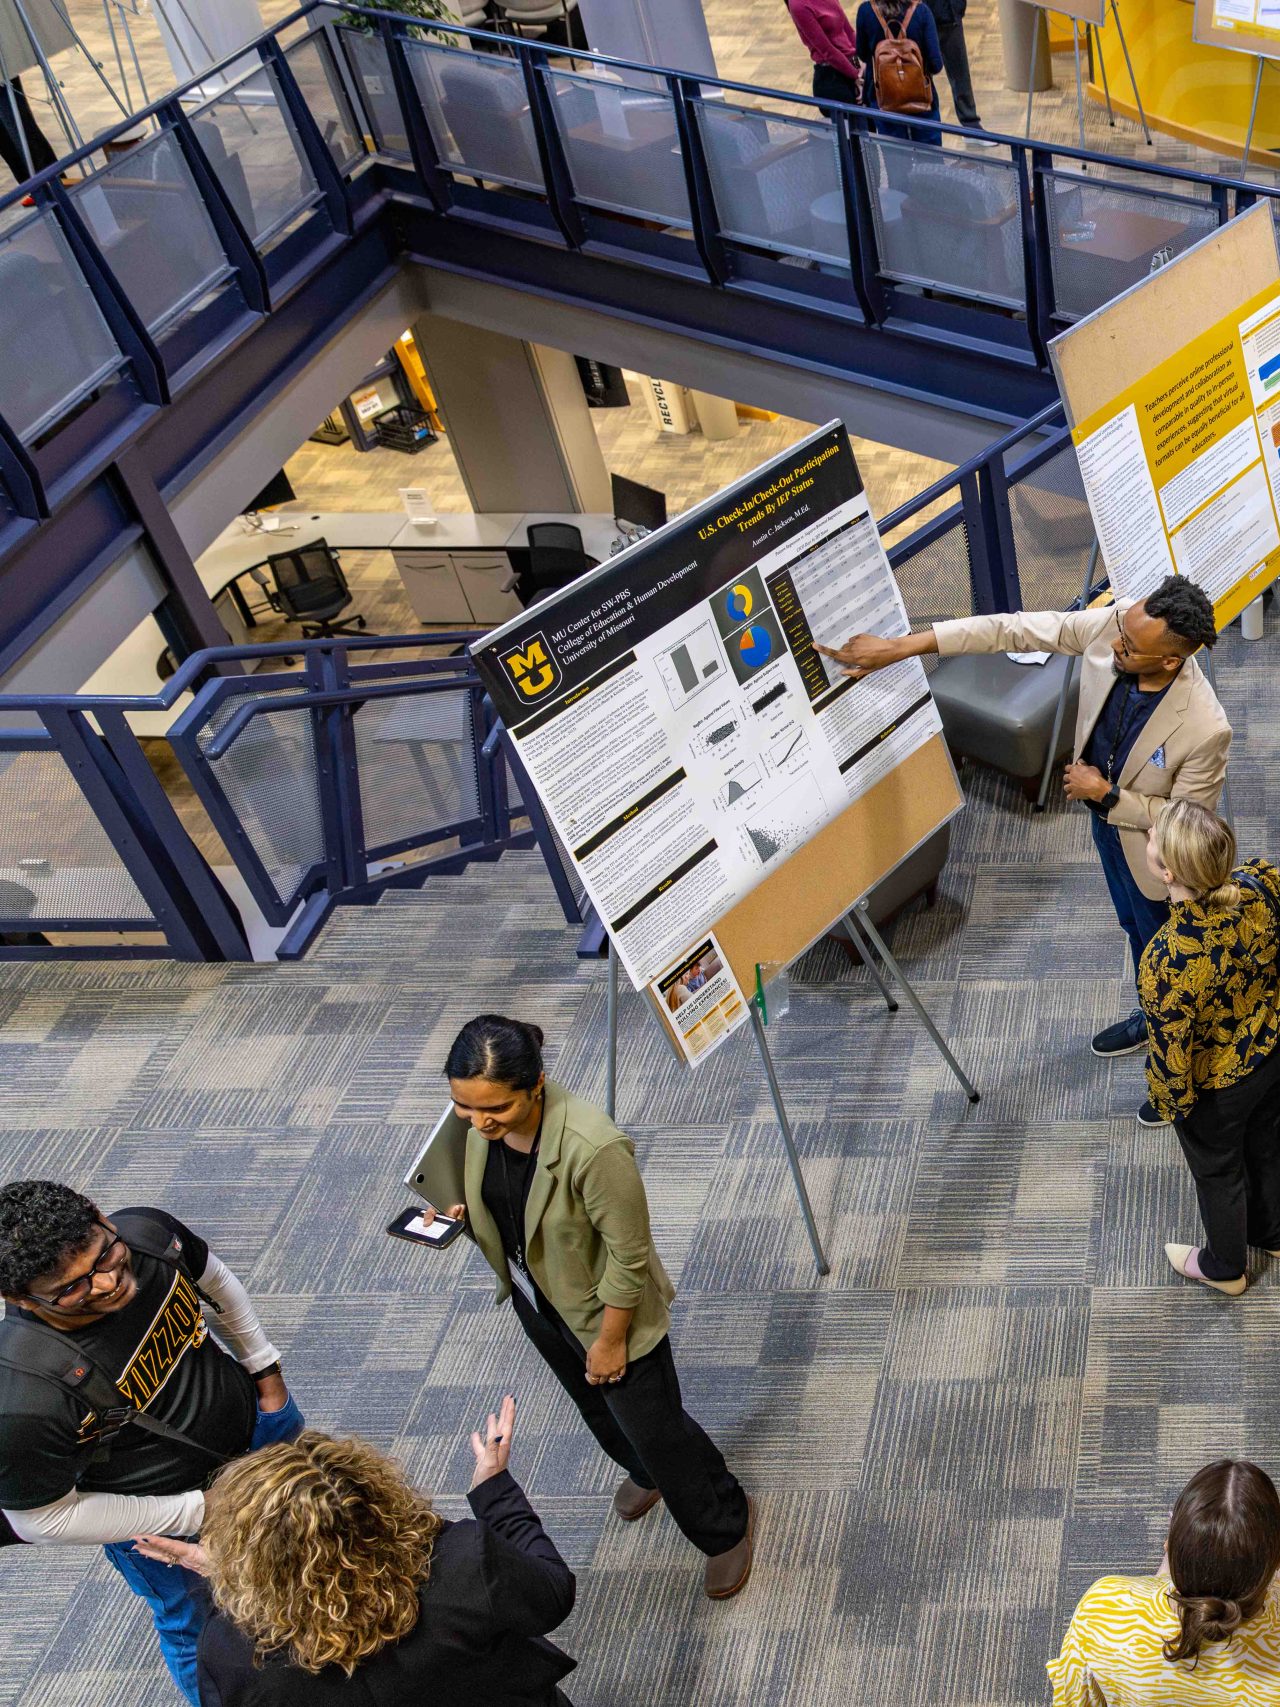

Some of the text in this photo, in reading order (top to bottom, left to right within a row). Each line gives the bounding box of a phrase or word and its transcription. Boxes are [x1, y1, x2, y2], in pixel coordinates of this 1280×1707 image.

[1144, 340, 1234, 413] Teachers perceive online professional
[1151, 358, 1231, 424] development and collaboration as
[1154, 369, 1235, 438] comparable in quality to in-person
[1154, 446, 1175, 468] formats
[1174, 440, 1183, 452] can
[1183, 434, 1191, 445] be
[1190, 420, 1208, 440] equally
[1207, 401, 1231, 425] beneficial
[1231, 395, 1239, 408] for
[1155, 381, 1238, 452] experiences, suggesting that virtual
[1190, 429, 1216, 454] educators.
[697, 442, 840, 541] U.S. Check-In/Check-Out Participation
[736, 475, 814, 533] Trends By IEP Status
[750, 503, 810, 548] Austin C. Jackson, M.Ed.
[551, 587, 631, 644] MU Center for SW-PBS
[556, 559, 698, 656] College of Education & Human Development
[561, 612, 635, 667] University of Missouri
[507, 641, 555, 695] MU
[564, 684, 590, 705] Introduction
[622, 805, 639, 821] Method
[657, 877, 673, 892] Results
[675, 976, 721, 1020] HELP US UNDERSTAND
[677, 1003, 698, 1025] BULLYING
[697, 977, 727, 1006] EXPERIENCES!
